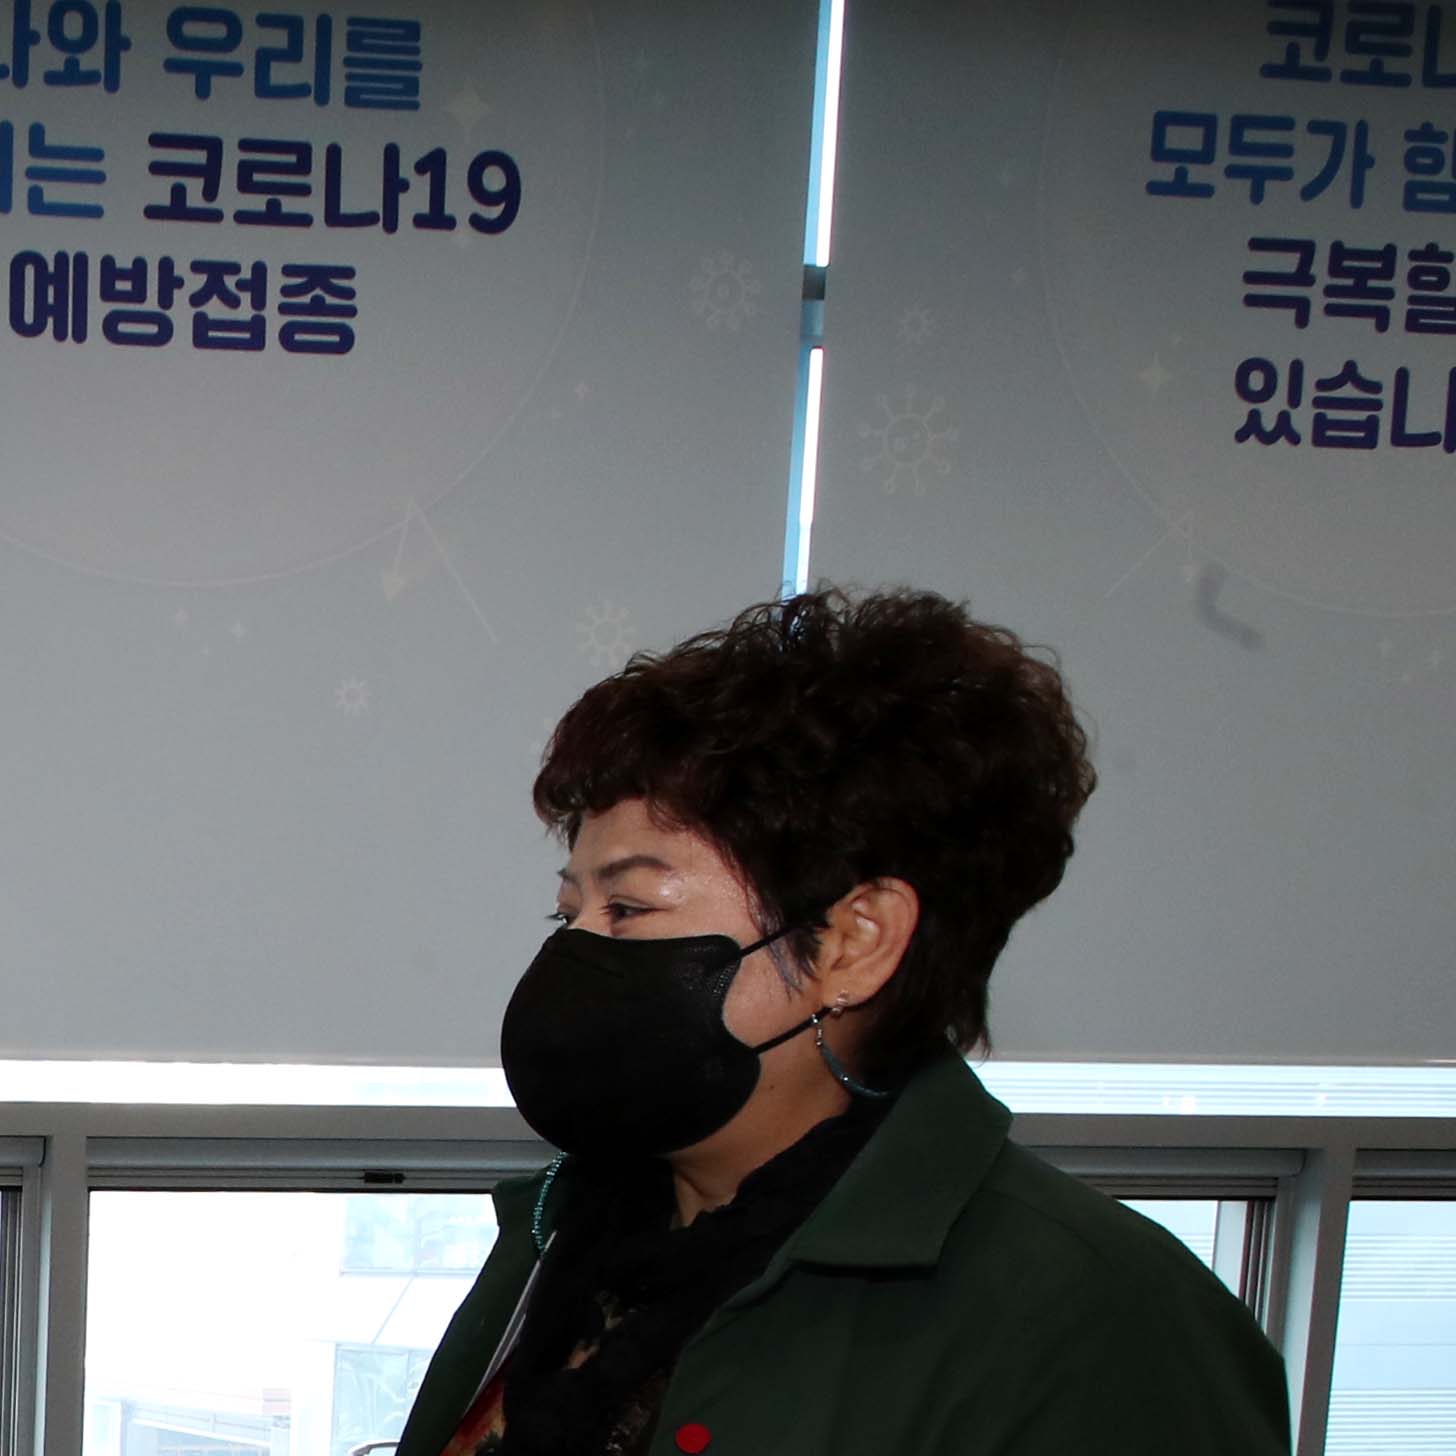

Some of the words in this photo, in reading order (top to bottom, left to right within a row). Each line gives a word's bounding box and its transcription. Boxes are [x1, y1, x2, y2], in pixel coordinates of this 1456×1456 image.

[162, 5, 423, 112] 우리를
[142, 131, 522, 236] 코로나19
[1145, 110, 1376, 209] 모두가
[8, 249, 359, 356] 예방접종
